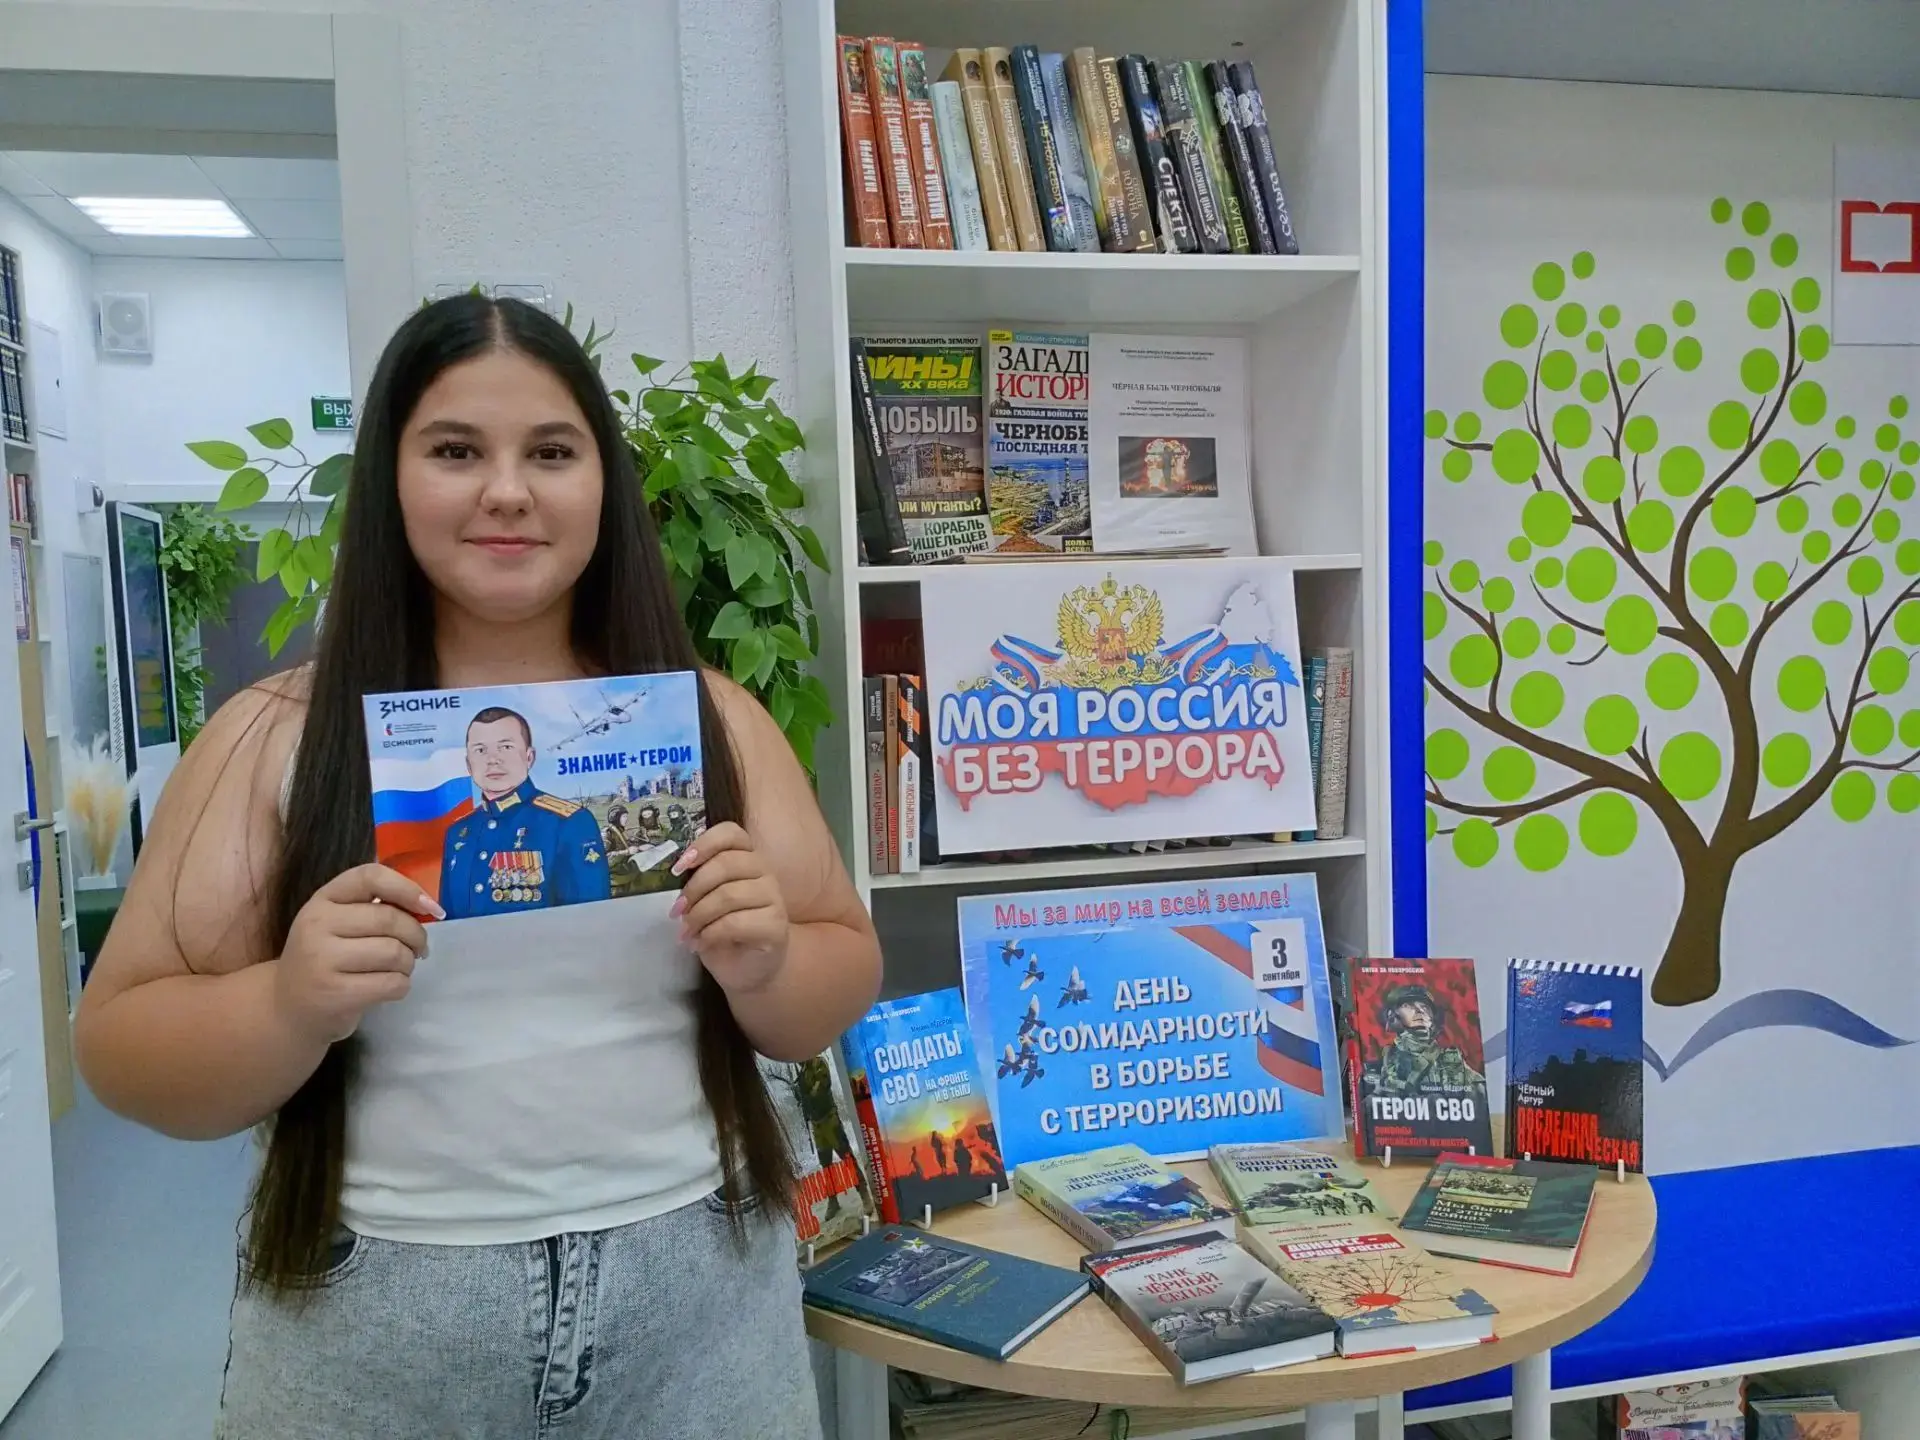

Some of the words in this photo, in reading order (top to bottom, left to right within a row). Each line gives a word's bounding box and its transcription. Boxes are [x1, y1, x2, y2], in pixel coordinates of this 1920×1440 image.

[1102, 65, 1120, 124] ЛОГИНОВА
[888, 117, 907, 155] ДОРОГА
[895, 158, 916, 217] ЛЕБЕДИНАЯ
[924, 173, 945, 219] ВОЛКОДАВ
[1122, 169, 1140, 220] ВОРОНА
[1228, 197, 1249, 249] КУПЕЦ
[948, 337, 978, 345] ЗЕМЛЮ?
[1013, 409, 1045, 417] ГАЗОВАЯ
[1047, 409, 1073, 418] ВОЙНА
[996, 441, 1078, 455] ПОСЛЕДНЯЯ
[924, 519, 985, 536] КОРАБЛЬ
[941, 549, 954, 558] НА
[940, 692, 1059, 743] МОЯ
[1077, 682, 1288, 736] РОССИЯ
[391, 738, 435, 746] СИНЕРГИЯ
[557, 754, 627, 776] ЗНАНИЕ
[640, 746, 692, 766] ГЕРОИ
[951, 744, 1041, 794] БЕЗ
[1058, 729, 1283, 786] ТЕРРОРА
[906, 783, 914, 839] ФАНТАСТИЧЕСКИХ
[994, 904, 1038, 928] Мы
[1043, 905, 1067, 924] за
[1075, 901, 1123, 925] мир
[1128, 899, 1154, 918] на
[1160, 889, 1211, 916] всей
[1215, 883, 1291, 912] земле!
[1271, 938, 1288, 969] 3
[1261, 970, 1302, 983] сентября
[1113, 976, 1192, 1012] ДЕНЬ
[1038, 1009, 1269, 1054] СОЛИДАРНОСТИ
[874, 1029, 963, 1074] СОЛДАТЫ
[1091, 1064, 1112, 1090] В
[1119, 1052, 1230, 1087] БОРЬБЕ
[881, 1073, 921, 1106] СВО
[925, 1078, 936, 1091] НА
[936, 1071, 970, 1088] ФРОНТЕ
[942, 1088, 949, 1101] В
[950, 1084, 972, 1099] ТЫЛУ
[1517, 1095, 1544, 1106] Артур
[1040, 1107, 1061, 1134] С
[1066, 1087, 1284, 1131] ТЕРРОРИЗМОМ
[1372, 1097, 1429, 1120] ГЕРОИ
[1436, 1098, 1475, 1121] СВО
[1517, 1107, 1598, 1138] ПОСЛЕДНЯЯ
[1236, 1156, 1333, 1167] ДОНБАССКИЙ
[1517, 1130, 1640, 1168] ПАТРИОТИЧЕСКАЯ
[1066, 1163, 1151, 1184] ДОНБАССКИЙ
[1066, 1168, 1160, 1192] ДЕКАМЕРОН
[1238, 1163, 1339, 1173] МЕРИДИАН
[1436, 1199, 1461, 1209] Мы
[1288, 1236, 1362, 1254] ДОНБАСС
[1292, 1247, 1344, 1261] СЕРДЦЕ
[1350, 1241, 1402, 1255] РОССИИ
[1143, 1267, 1190, 1283] ТАНК
